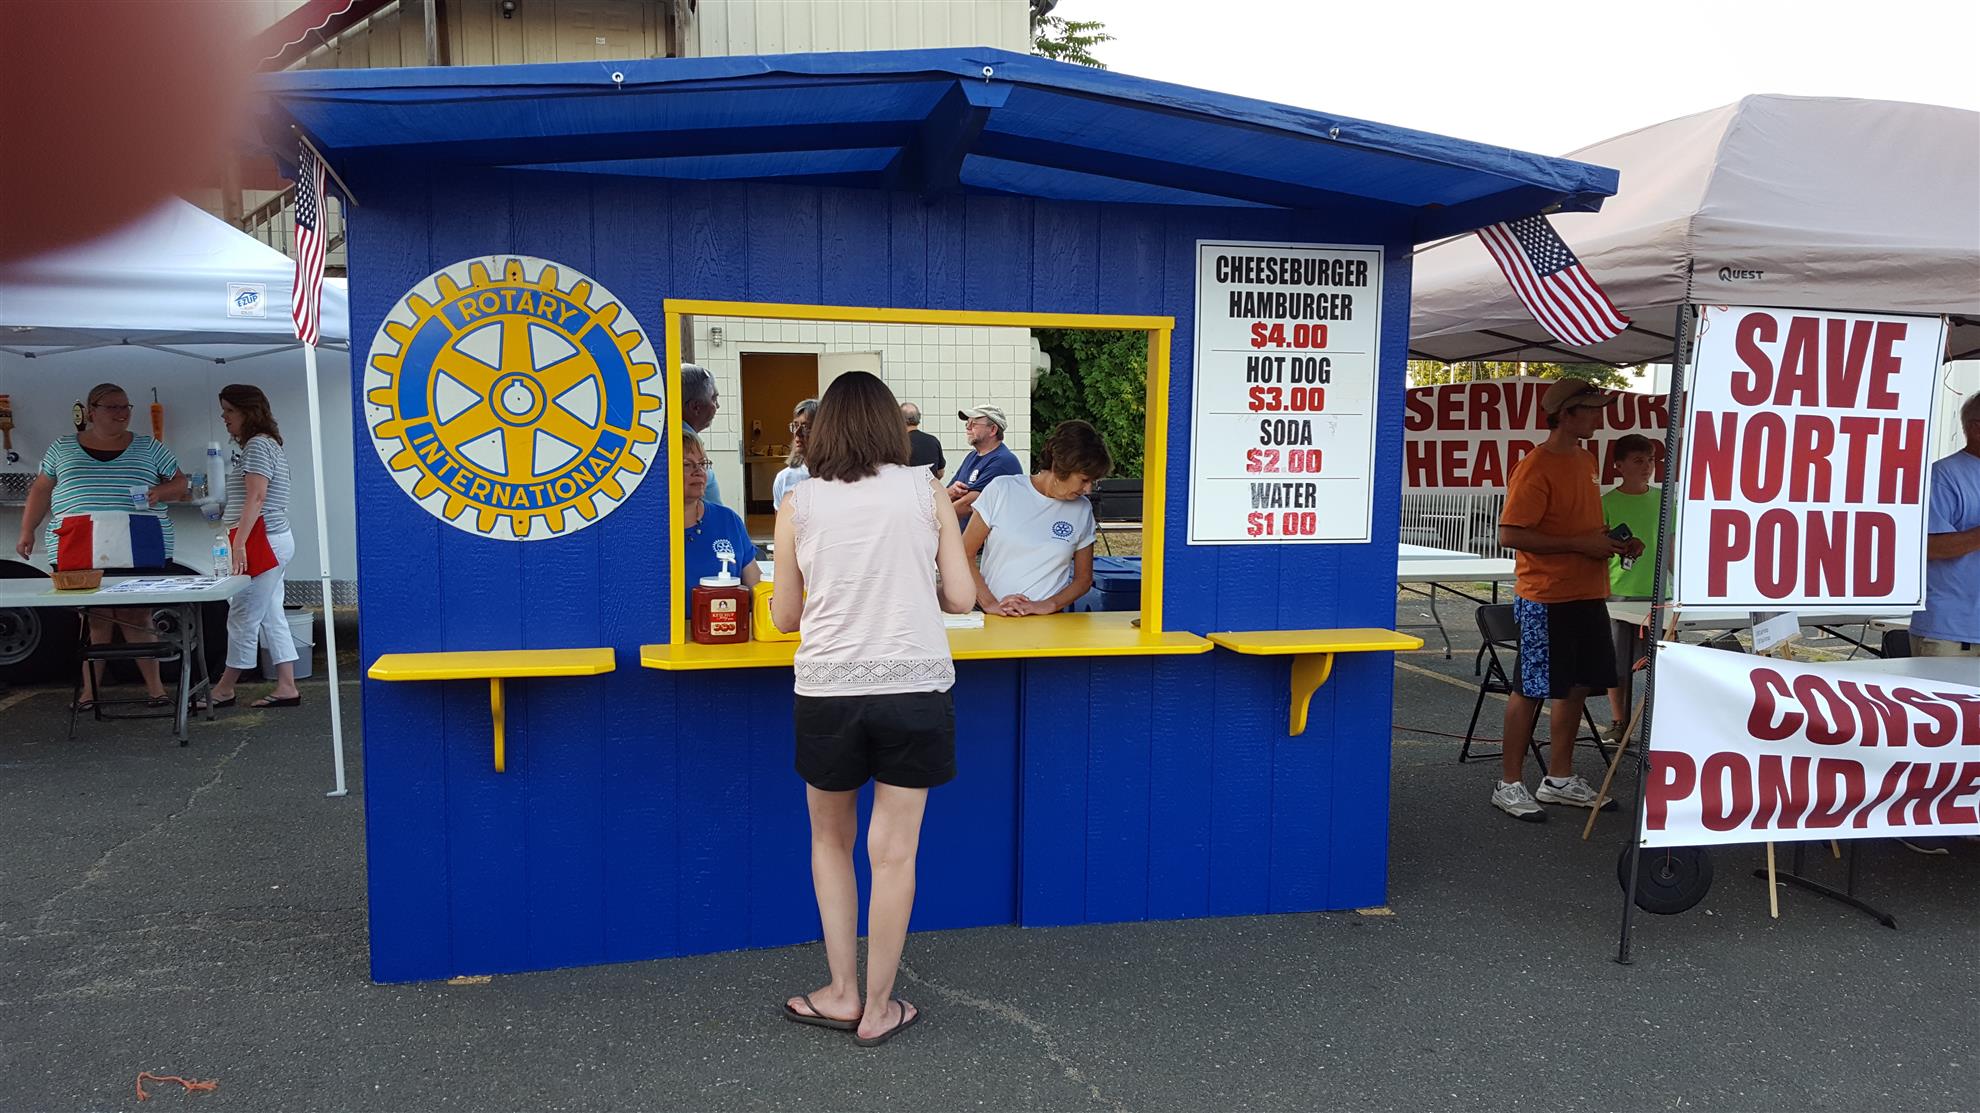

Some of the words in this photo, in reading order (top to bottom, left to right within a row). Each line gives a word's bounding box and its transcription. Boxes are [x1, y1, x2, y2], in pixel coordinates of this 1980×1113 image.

[1216, 255, 1368, 287] CHEESEBURGER
[457, 289, 580, 325] ROTARY
[1229, 291, 1352, 320] HAMBURGER
[1250, 321, 1328, 349] $4.00
[1246, 356, 1286, 384] HOT
[1291, 356, 1331, 385] DOG
[1730, 312, 1908, 410] SAVE
[1248, 384, 1325, 412] $3.00
[1259, 418, 1313, 446] SODA
[412, 432, 620, 508] INTERNATIONAL
[1246, 447, 1322, 475] $2.00
[1689, 411, 1925, 504] NORTH
[1250, 481, 1317, 509] WATER
[1247, 511, 1317, 538] $1.00
[1707, 508, 1896, 599] POND
